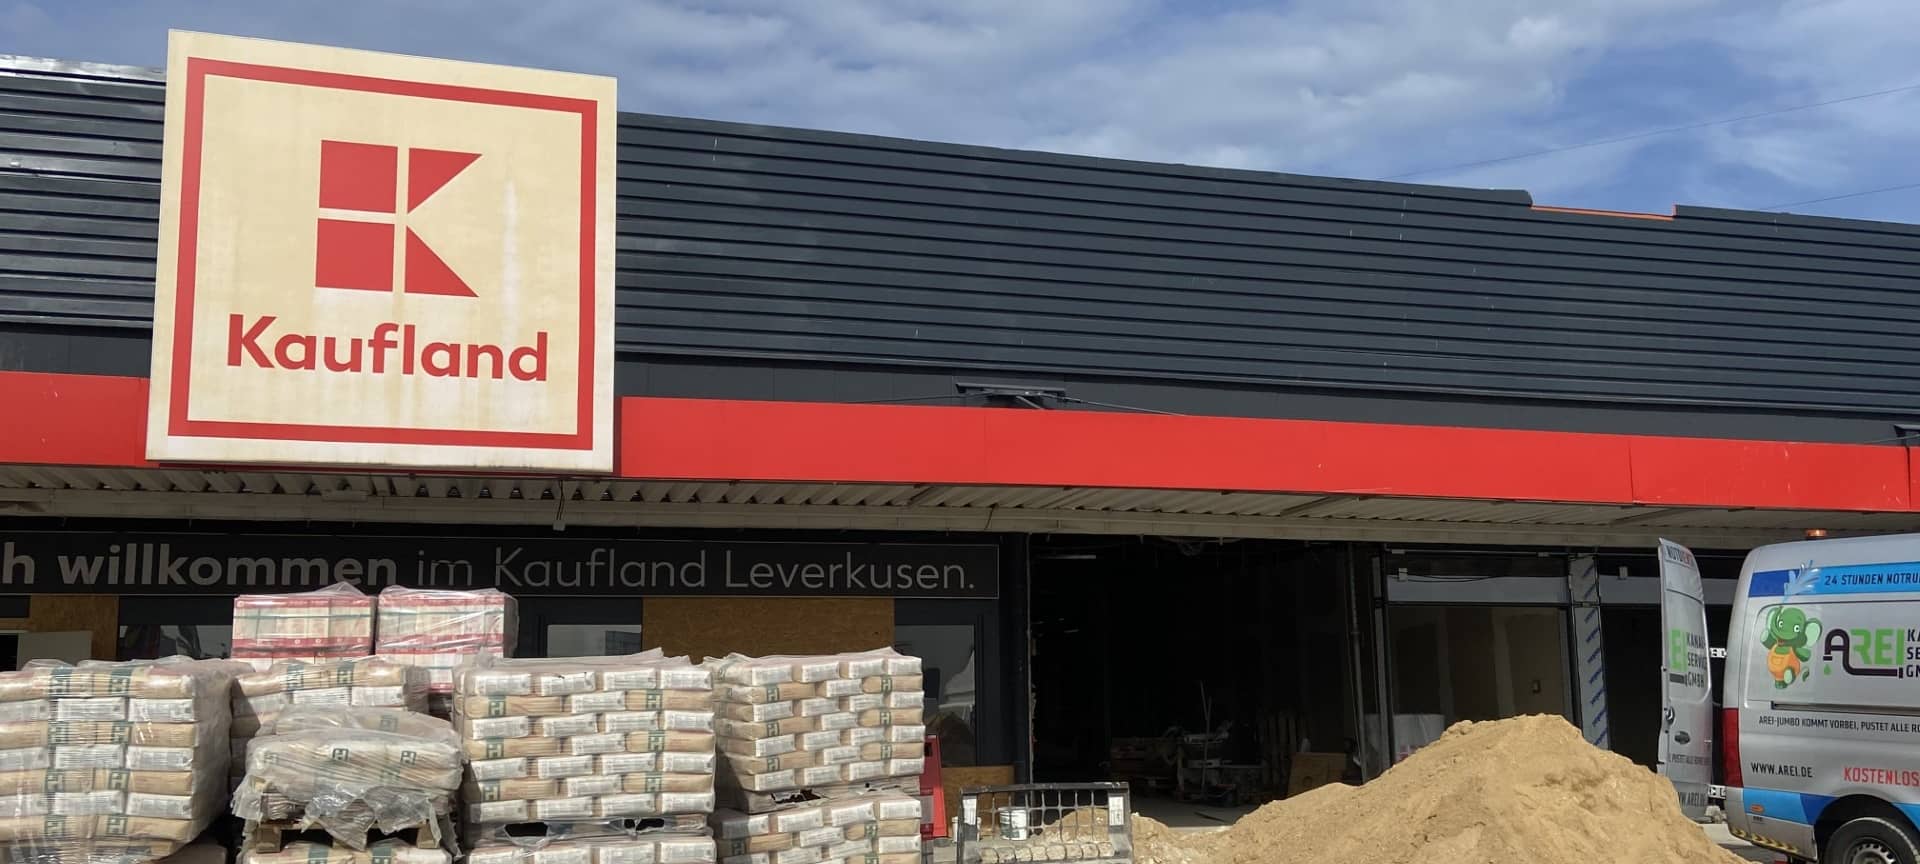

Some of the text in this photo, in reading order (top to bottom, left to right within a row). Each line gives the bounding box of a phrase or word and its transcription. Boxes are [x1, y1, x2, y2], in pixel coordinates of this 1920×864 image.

[227, 313, 548, 381] Kaufland
[57, 543, 397, 586] willkommen
[418, 549, 473, 586] im
[495, 547, 706, 588] Kaufland
[725, 549, 976, 589] Leverkusen.
[1824, 572, 1920, 586] 24 STUNDEN NOTRU
[1823, 628, 1905, 676] AREI
[1759, 715, 1800, 728] AREI-JUMBO
[1802, 717, 1828, 729] KOMMT
[1830, 718, 1859, 732] VORBEI,
[1861, 720, 1889, 733] PUSTET
[1891, 722, 1910, 733] ALLE
[1751, 762, 1814, 778] WWW.AREI.DE
[1844, 766, 1920, 787] KOSTENLOS
